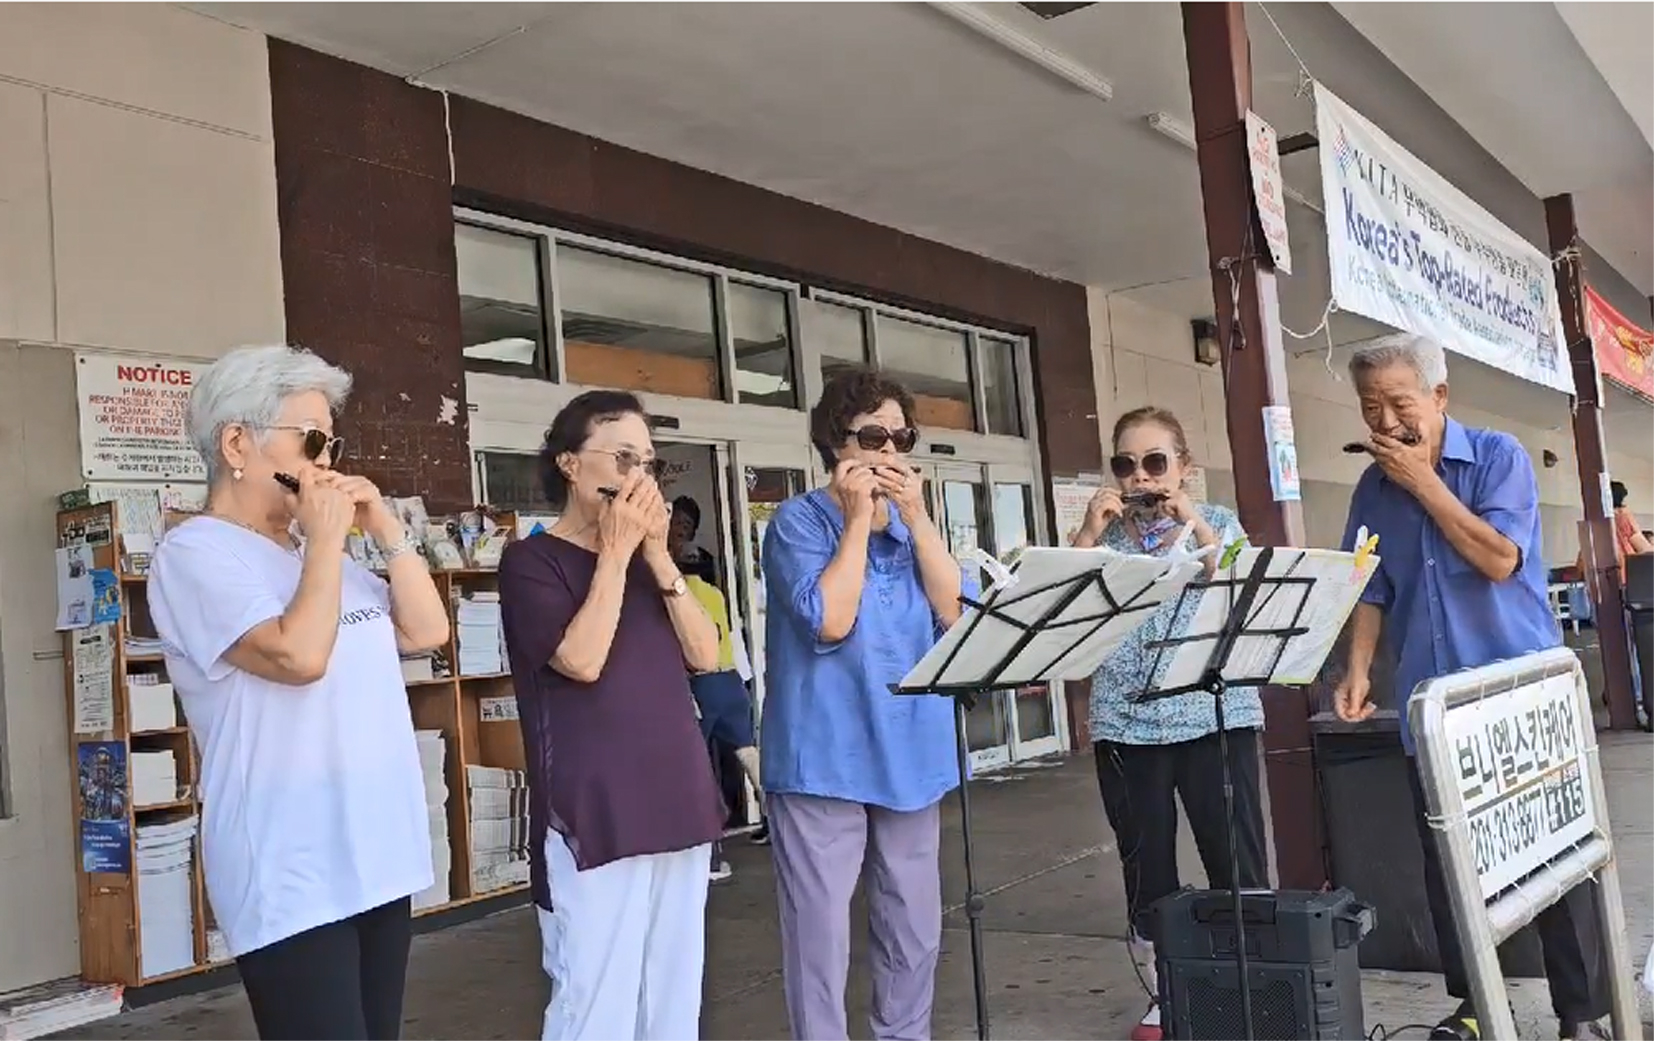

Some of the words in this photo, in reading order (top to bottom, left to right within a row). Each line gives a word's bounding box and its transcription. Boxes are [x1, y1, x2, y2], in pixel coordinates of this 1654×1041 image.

[1342, 187, 1413, 273] Korea's
[1410, 230, 1484, 311] Top-Rated
[1485, 273, 1536, 336] Products
[1348, 254, 1384, 293] Korea
[117, 365, 193, 385] NOTICE
[88, 395, 149, 407] RESPONSIBLE
[131, 388, 157, 398] MART
[95, 415, 110, 424] OR
[111, 416, 159, 425] PROPERTY
[109, 425, 124, 434] ON
[1456, 694, 1578, 801] 브니엘스킨케어
